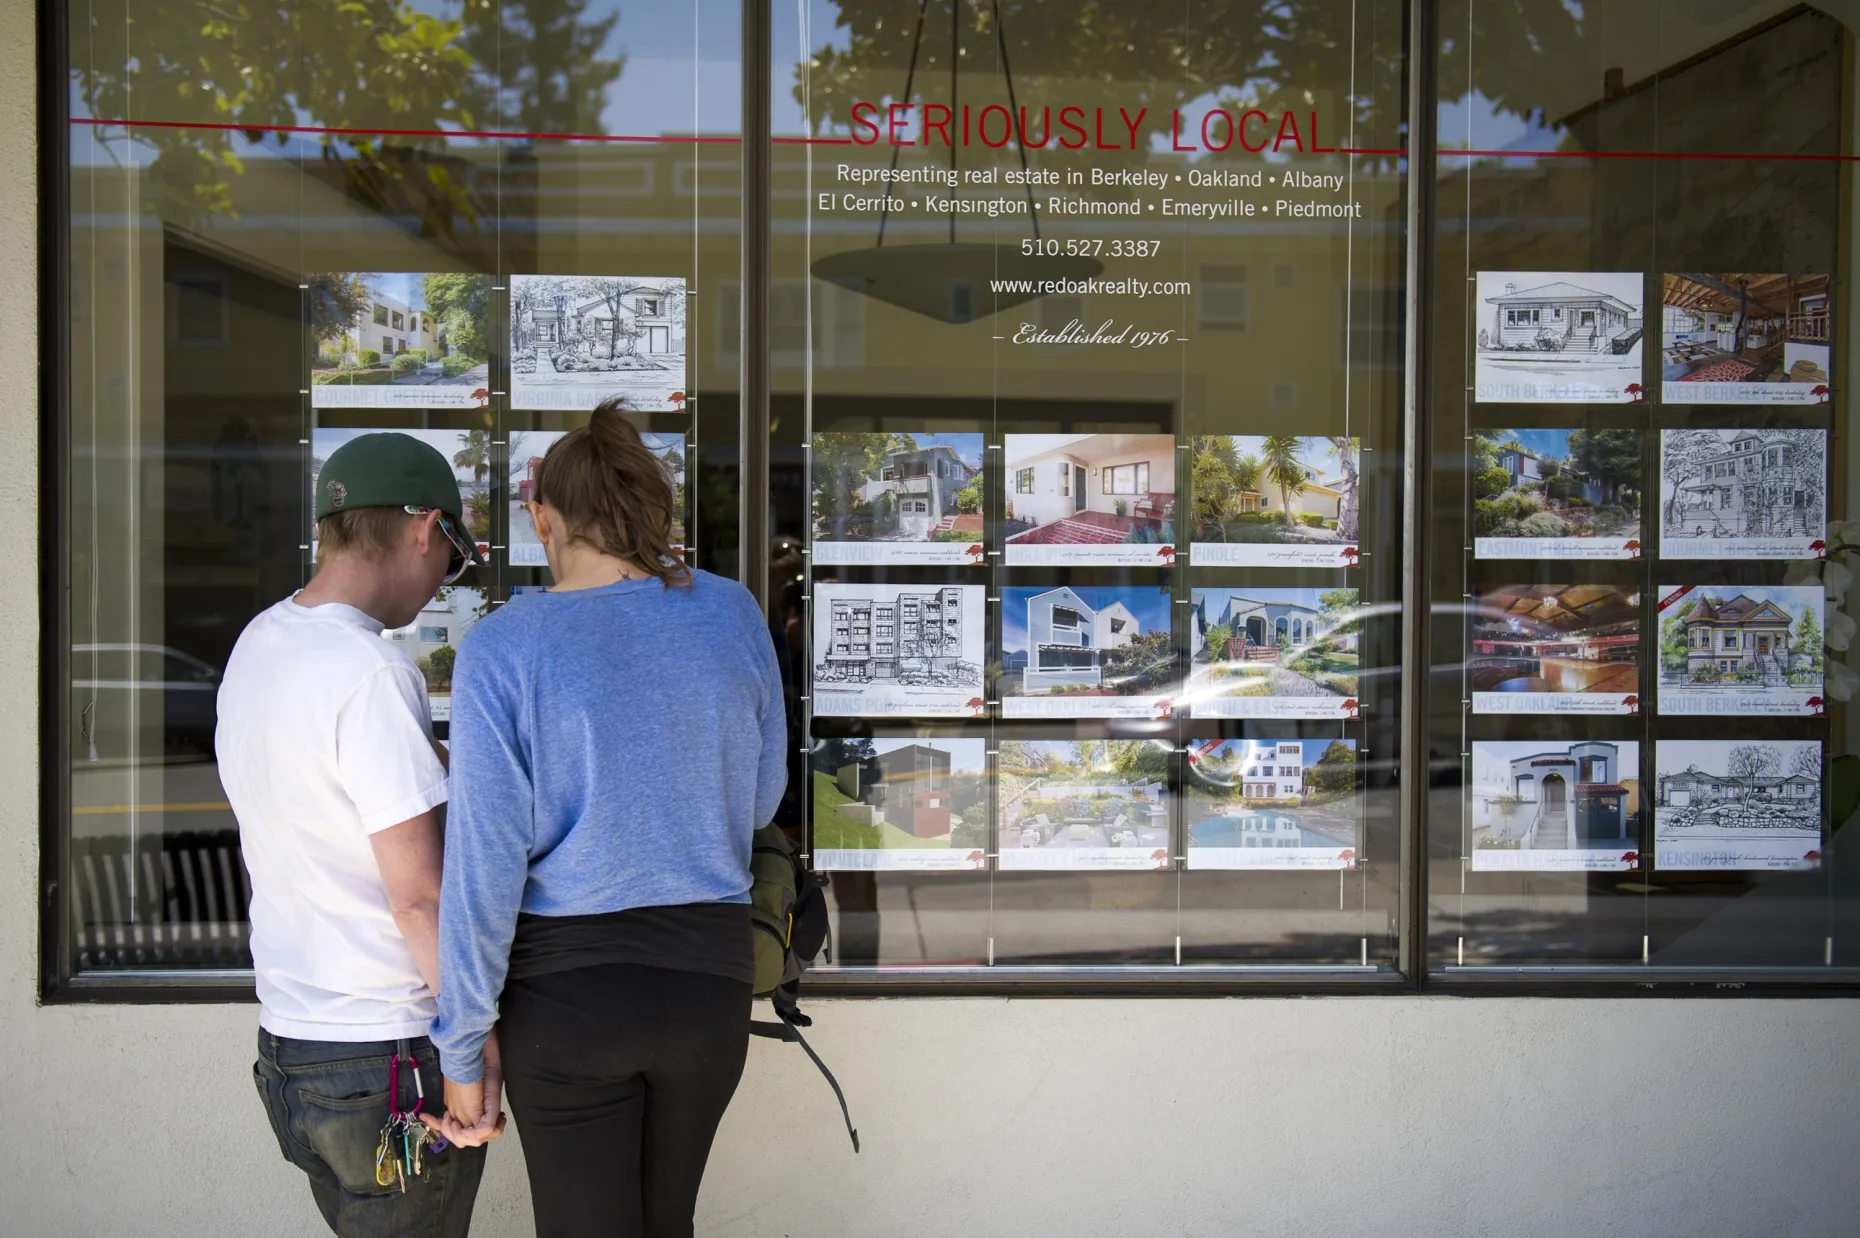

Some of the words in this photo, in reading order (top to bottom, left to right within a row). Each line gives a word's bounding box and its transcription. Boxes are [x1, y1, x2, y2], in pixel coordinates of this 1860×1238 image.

[852, 102, 1147, 150] SERIOUSLY
[1173, 109, 1336, 153] LOCAL
[838, 164, 958, 186] Representing
[965, 167, 997, 183] real
[1005, 168, 1059, 184] estate
[1068, 168, 1082, 184] in
[1092, 169, 1168, 189] Berkeley
[1189, 170, 1261, 186] Oakland
[1283, 171, 1343, 191] Albany
[819, 193, 835, 210] El
[843, 194, 904, 211] Cerrito
[926, 196, 1026, 217] Kensington
[1050, 197, 1140, 214] Richmond
[1163, 199, 1254, 219] Emeryville
[1277, 201, 1361, 217] Piedmont
[1022, 239, 1160, 257] 510.527.3387
[991, 277, 1190, 298] www.redoakrealty.com
[1013, 319, 1129, 345] Established
[1130, 327, 1173, 348] 1976
[316, 389, 378, 405] GOURMET
[514, 390, 571, 407] VIRGINIA
[1478, 383, 1519, 399] SOUTH
[1664, 385, 1700, 401] WEST
[513, 546, 547, 563] ALBA
[816, 544, 884, 561] GLENVIEW
[1194, 546, 1239, 561] PINOLE
[1478, 541, 1543, 557] EASTMONT
[1663, 541, 1725, 556] GOURMET
[816, 698, 862, 713] ADAMS
[1476, 696, 1511, 711] WEST
[1660, 697, 1702, 713] SOUTH
[1658, 851, 1737, 867] KENSINGTON
